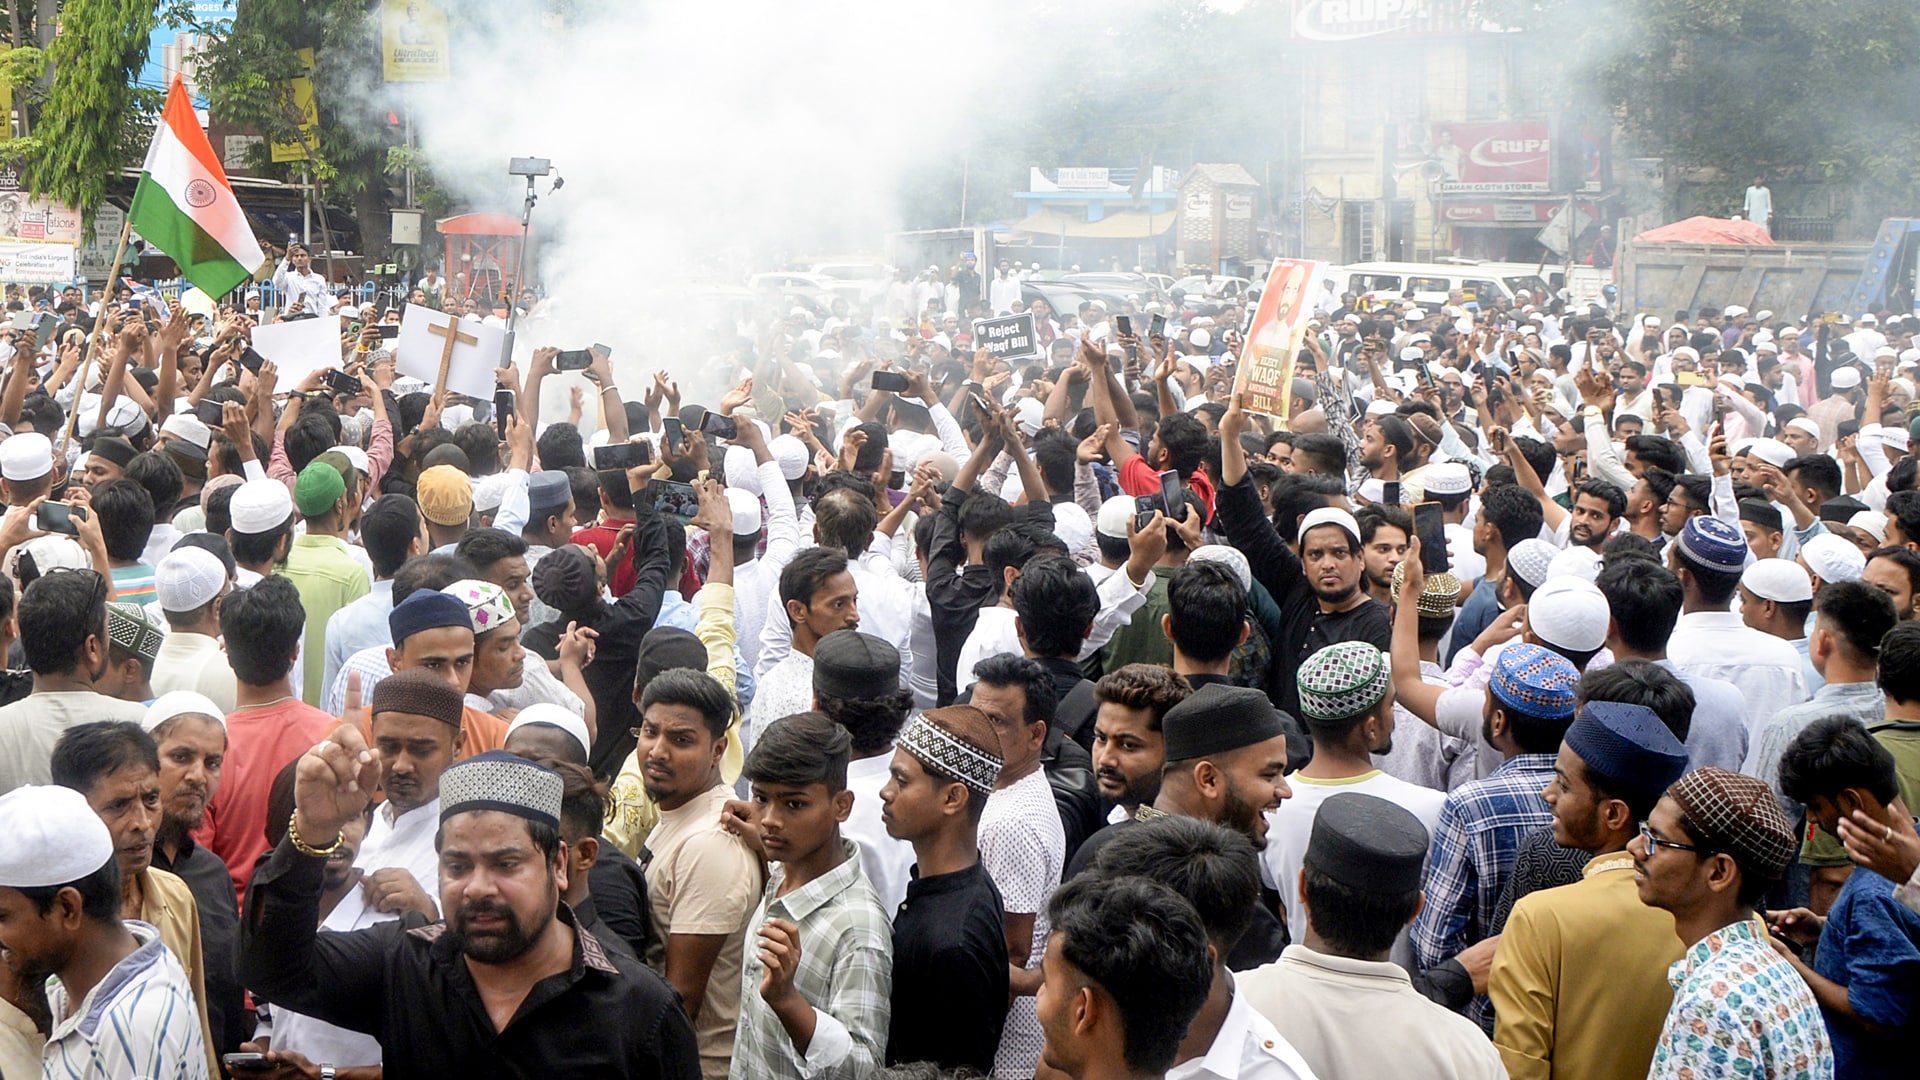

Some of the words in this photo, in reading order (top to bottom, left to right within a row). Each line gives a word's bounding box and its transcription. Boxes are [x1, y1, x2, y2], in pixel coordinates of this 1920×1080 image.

[47, 254, 69, 262] Largest
[988, 323, 1020, 338] Reject
[984, 339, 1009, 353] Waqf
[1011, 336, 1028, 349] Bill
[1251, 365, 1281, 387] WAQF
[1252, 394, 1273, 411] BILL
